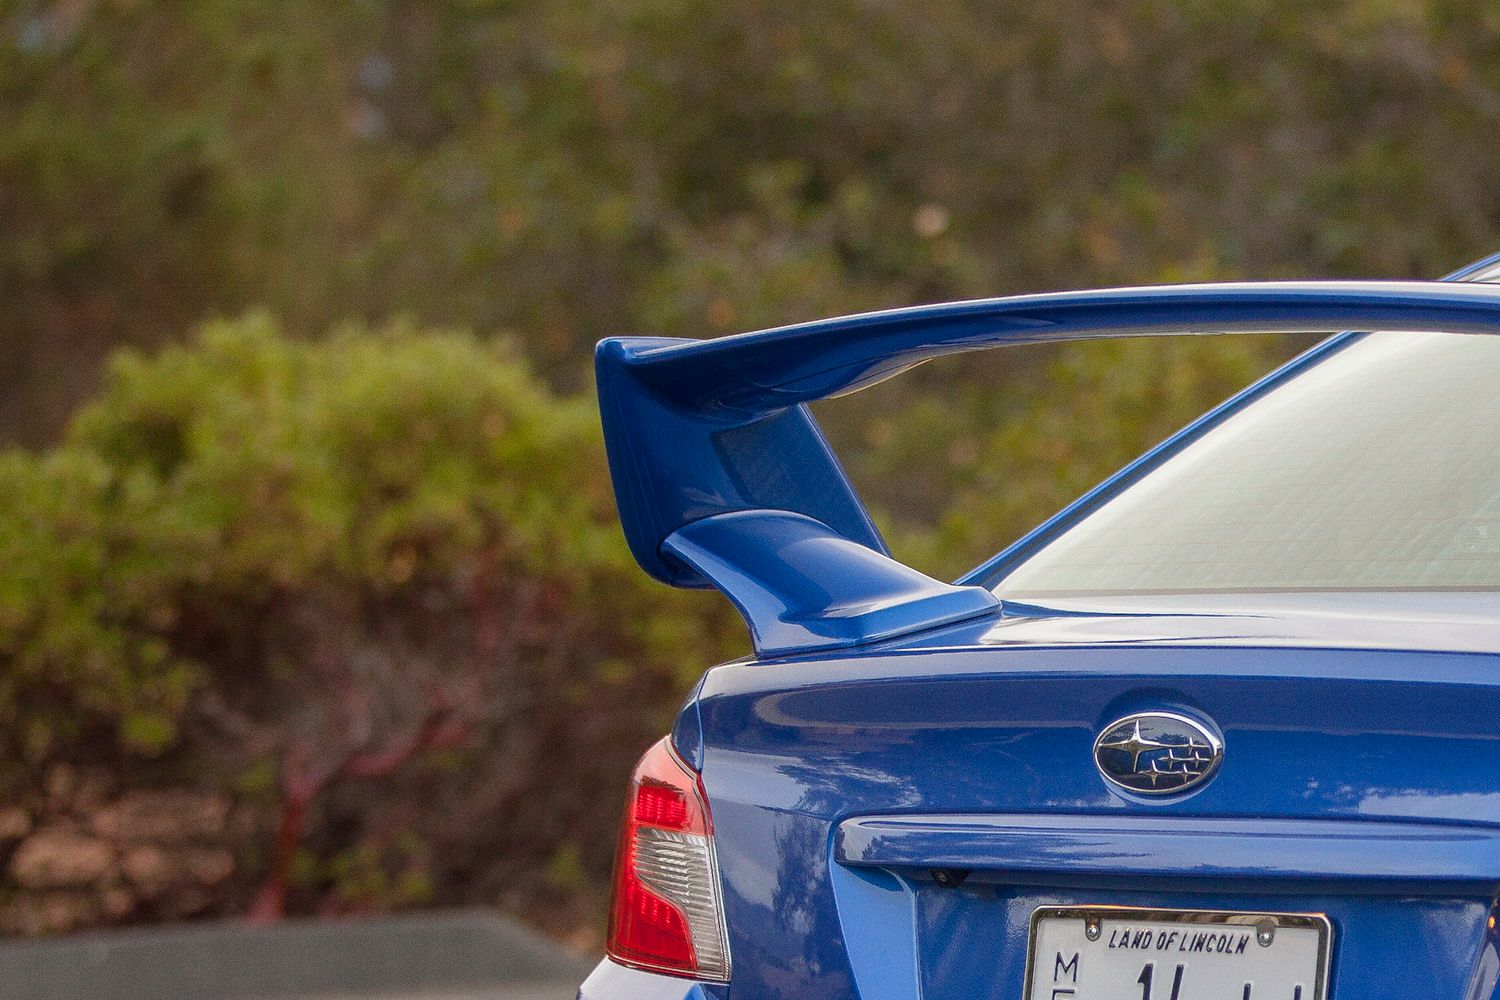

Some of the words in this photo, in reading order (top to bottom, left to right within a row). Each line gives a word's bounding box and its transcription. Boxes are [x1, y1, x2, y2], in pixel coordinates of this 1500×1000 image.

[1108, 929, 1153, 950] LAND
[1156, 931, 1179, 951] OF
[1179, 932, 1250, 955] LINCOLN
